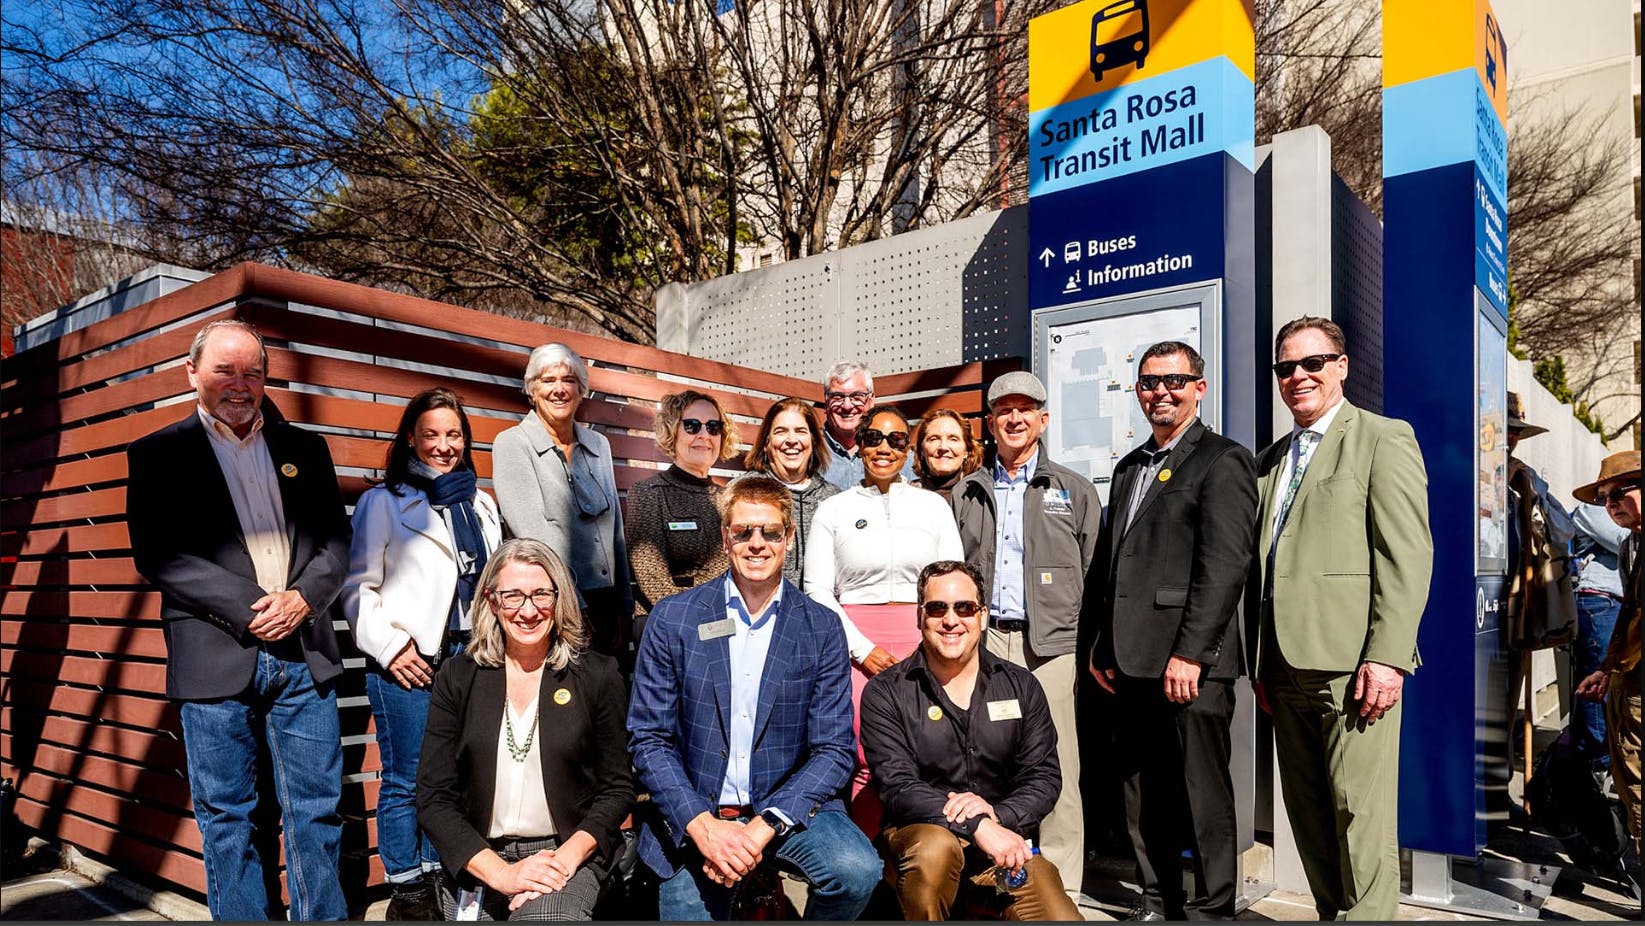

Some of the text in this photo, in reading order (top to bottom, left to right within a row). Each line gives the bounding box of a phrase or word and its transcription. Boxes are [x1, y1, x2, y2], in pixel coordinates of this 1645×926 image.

[1040, 85, 1197, 147] Santa Rosa
[1040, 112, 1204, 182] Transit Mall
[1088, 235, 1137, 257] Buses
[1088, 254, 1193, 286] Information
